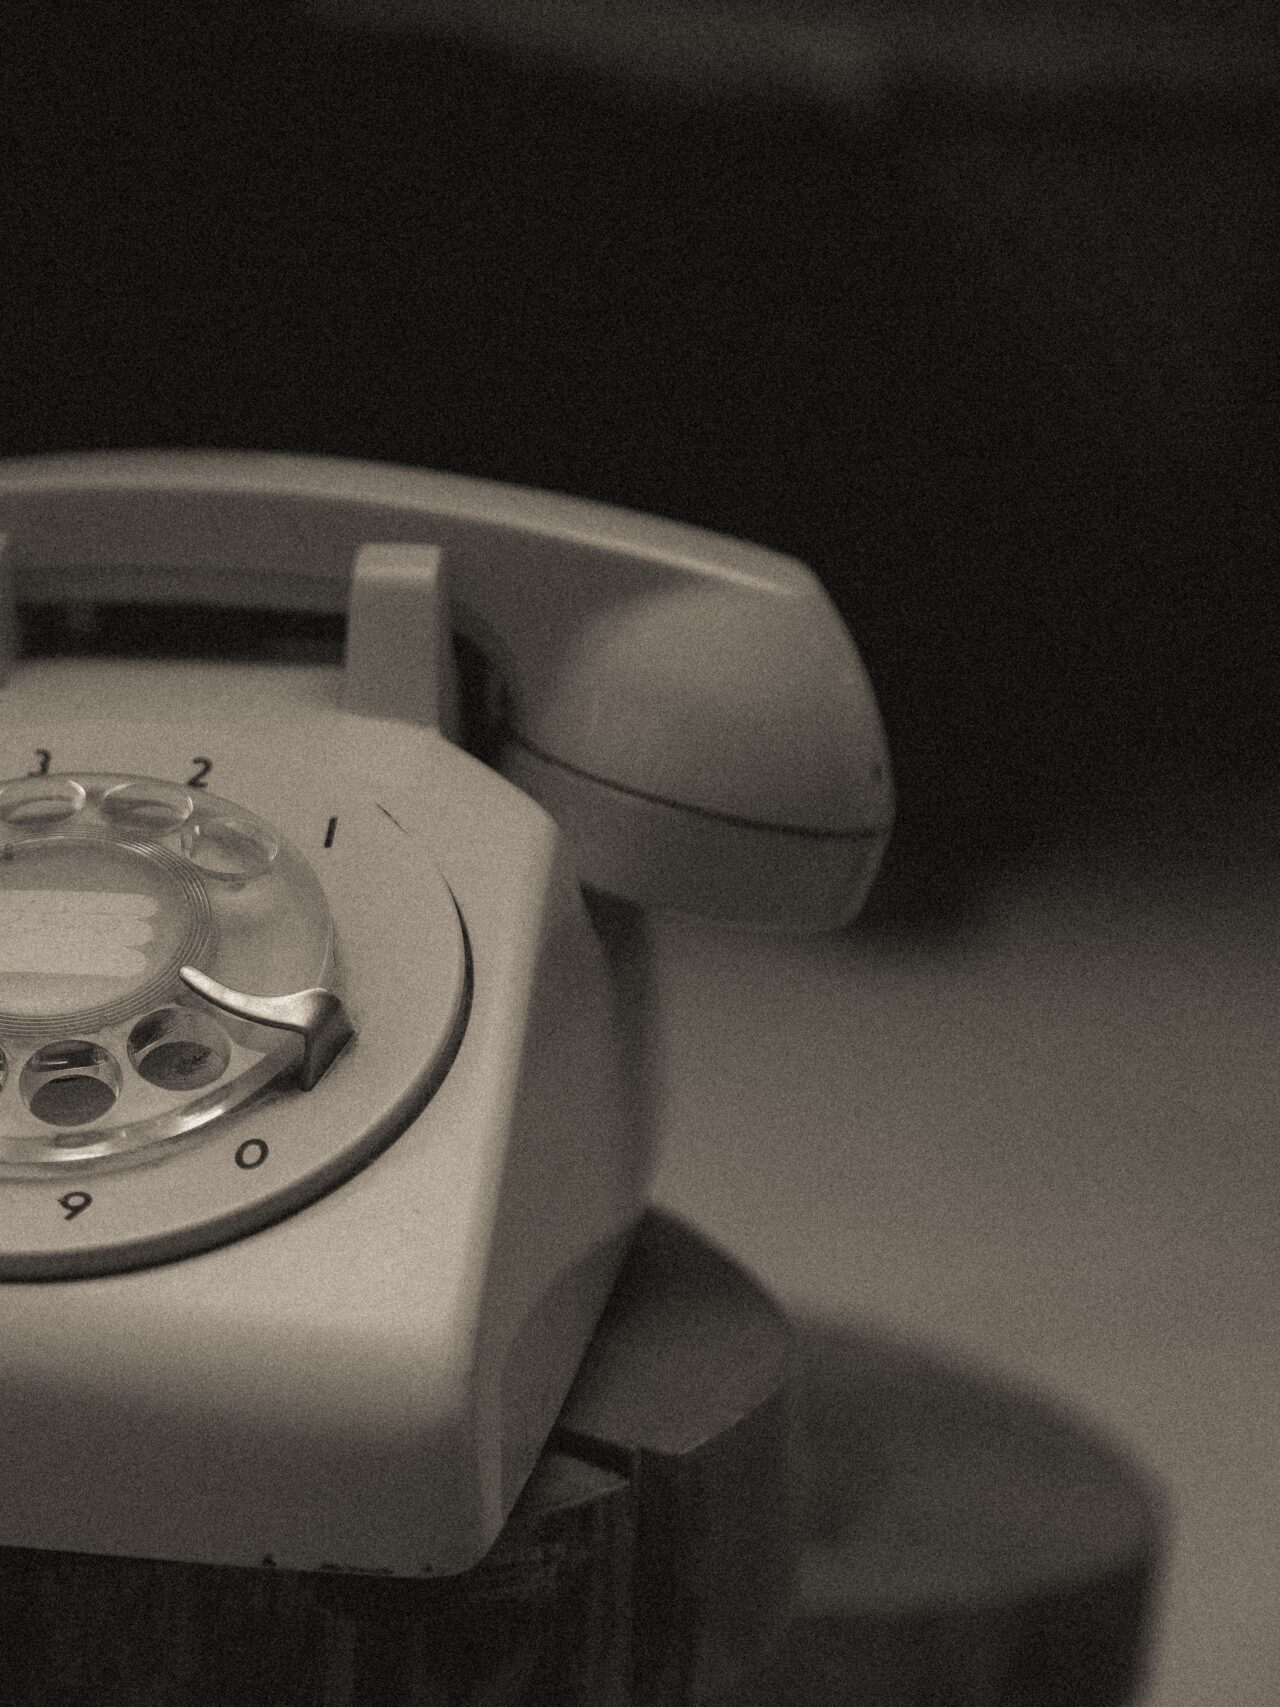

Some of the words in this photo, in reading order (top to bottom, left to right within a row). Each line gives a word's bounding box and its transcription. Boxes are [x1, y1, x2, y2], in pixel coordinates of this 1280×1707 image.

[27, 749, 52, 778] 3
[186, 757, 213, 790] 2
[323, 816, 338, 849] 1
[234, 1138, 269, 1170] 0
[58, 1191, 93, 1221] 9
